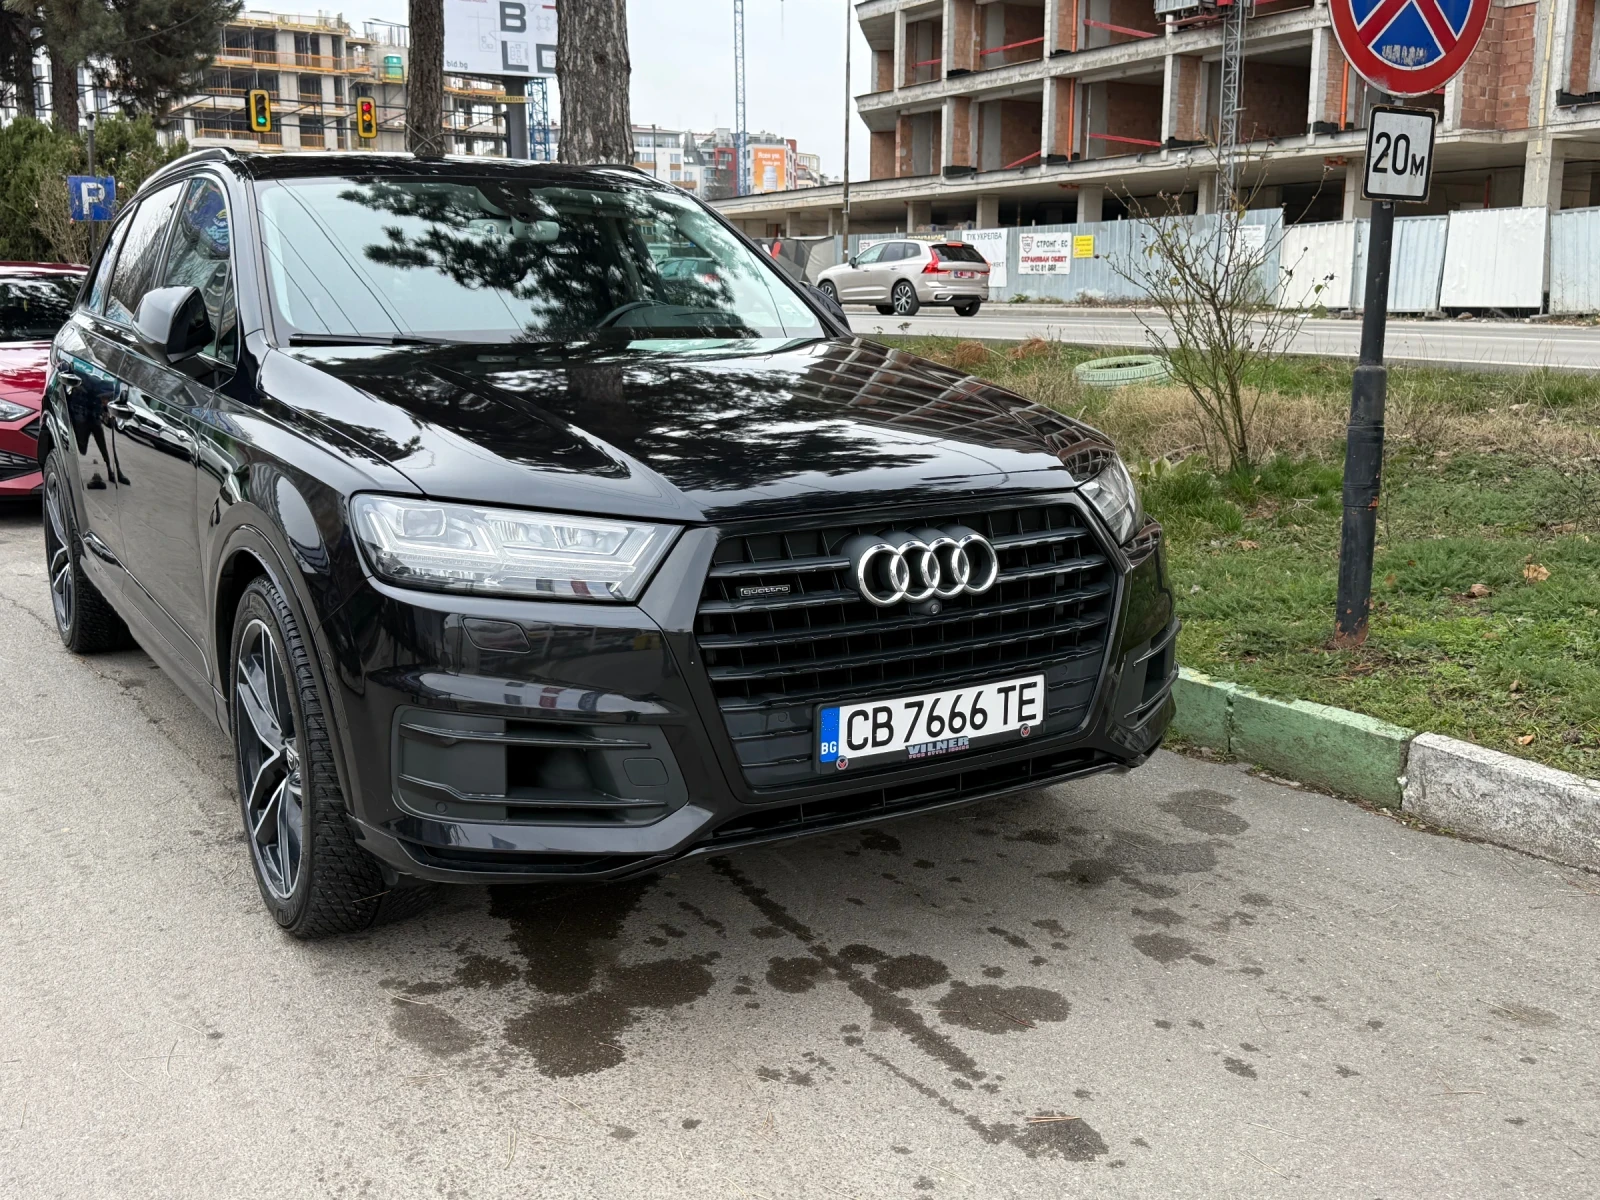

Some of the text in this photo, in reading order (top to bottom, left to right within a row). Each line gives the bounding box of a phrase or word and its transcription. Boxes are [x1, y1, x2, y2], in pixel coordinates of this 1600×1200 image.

[499, 1, 526, 33] B
[446, 60, 468, 70] bld.bg
[81, 182, 105, 214] P
[966, 231, 1002, 241] ТУК УКРЕПВА
[1036, 240, 1057, 248] СТРОНГ
[1061, 240, 1068, 248] ЕС
[741, 585, 790, 597] quattro
[821, 681, 1038, 755] BG CB 7666 TE
[907, 736, 969, 755] VILNER
